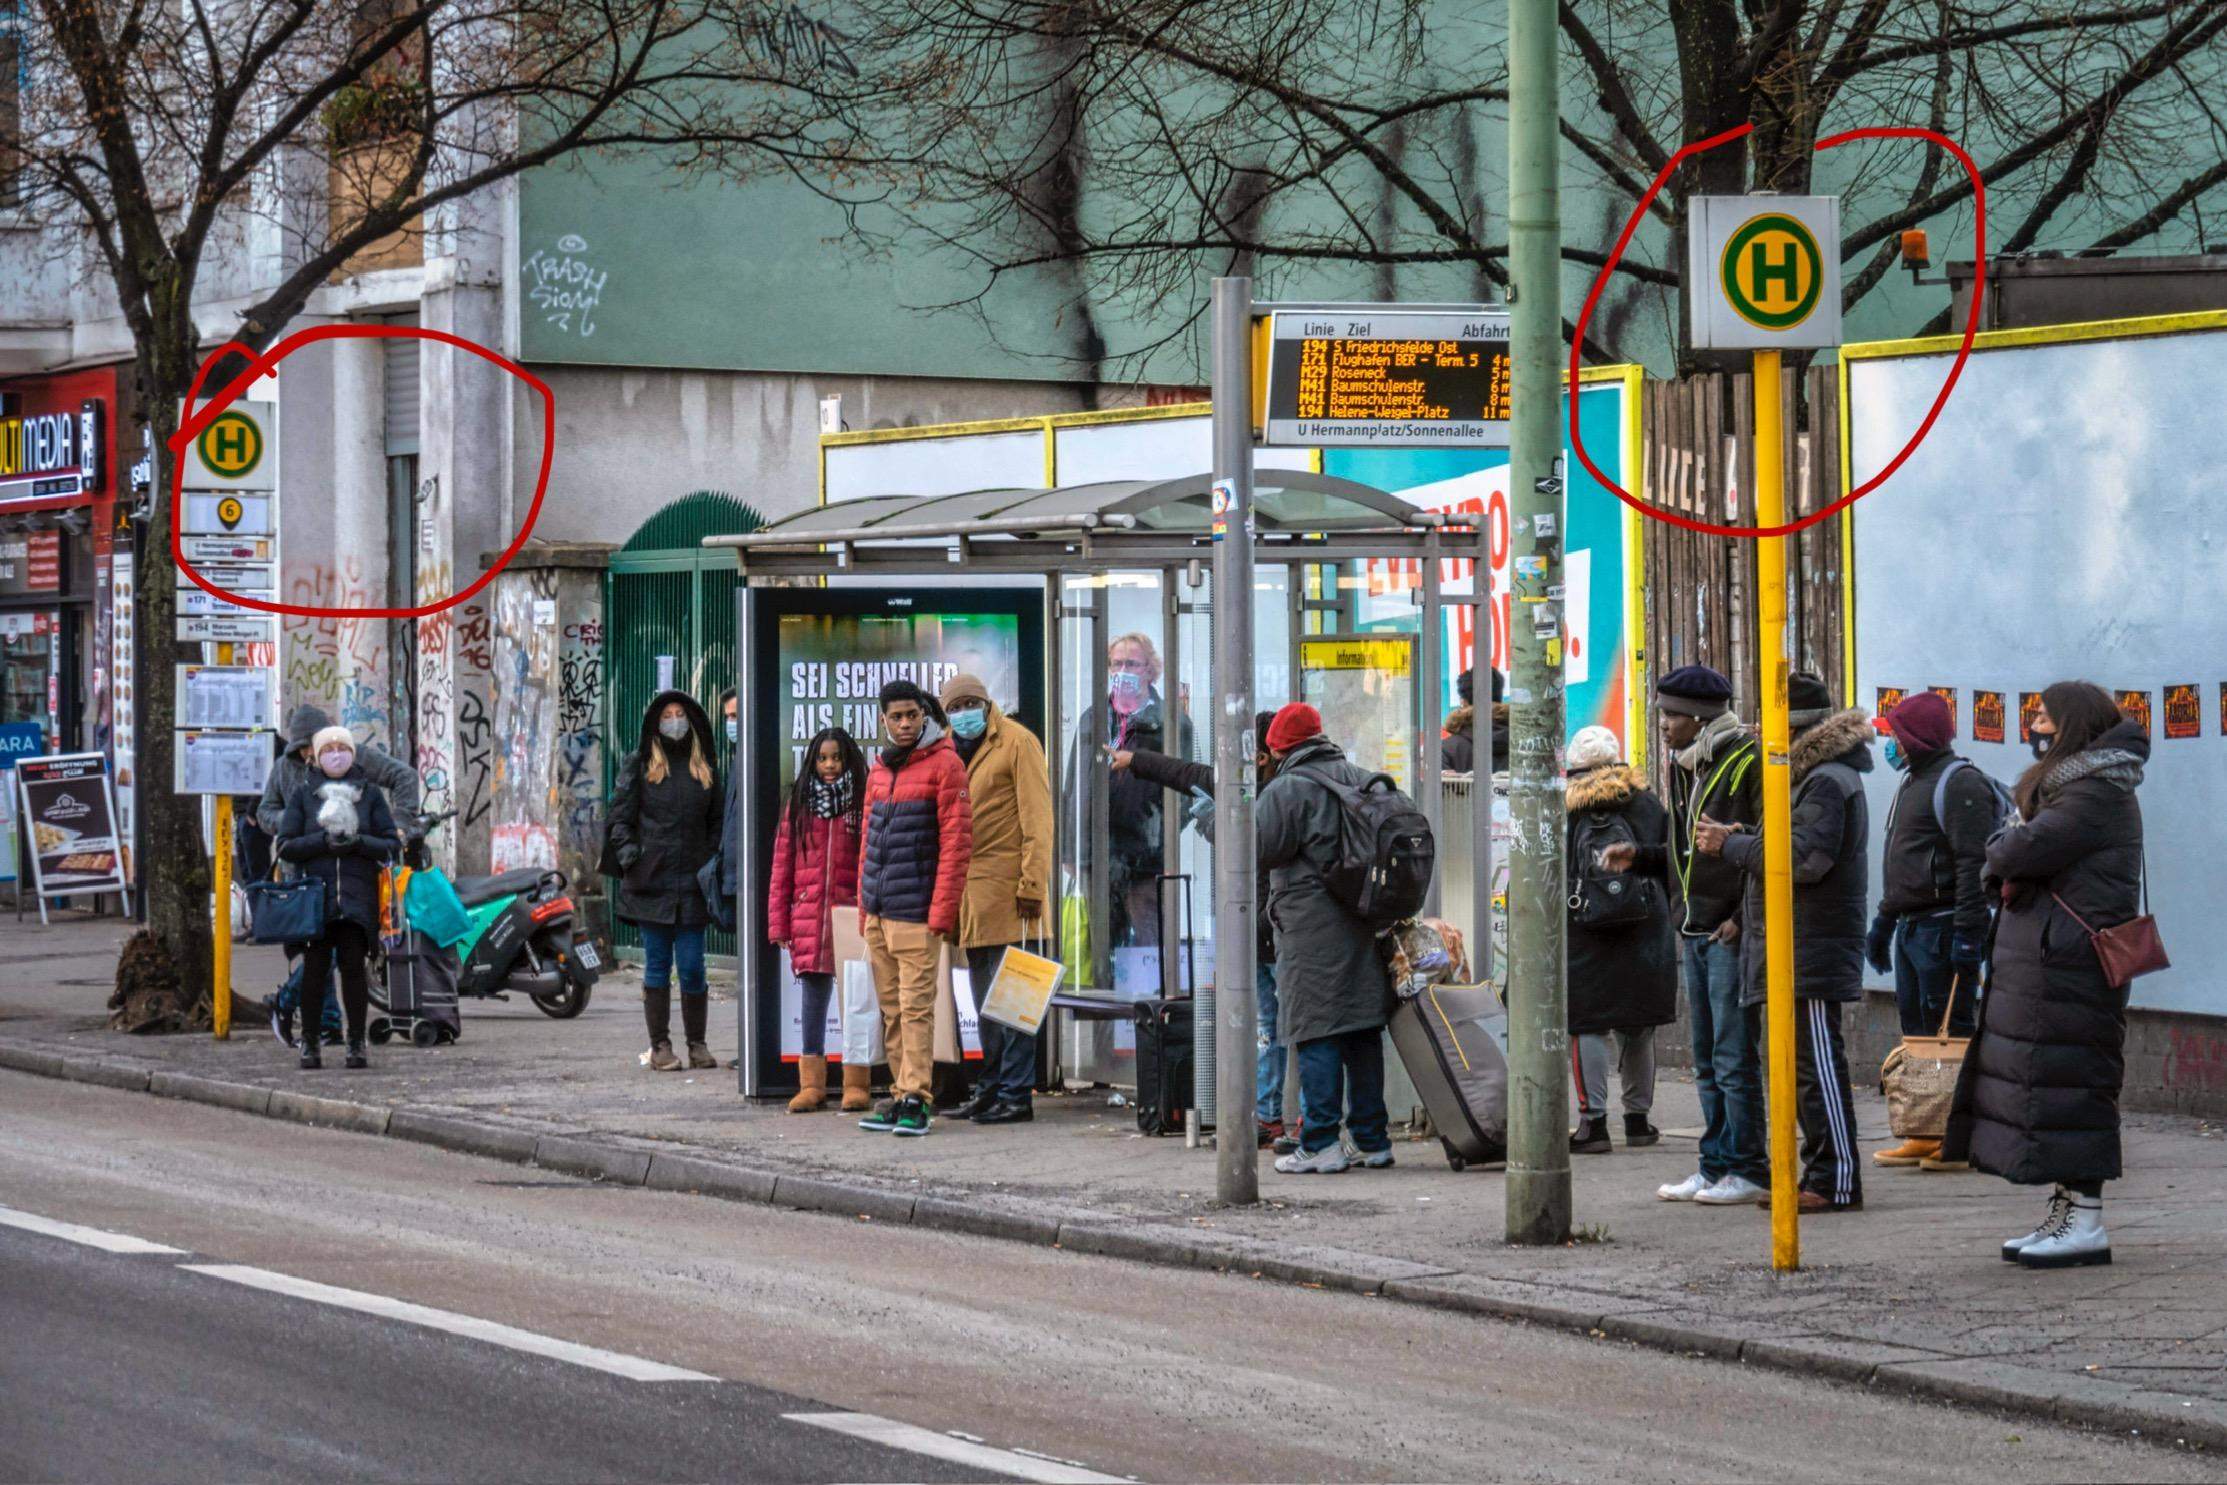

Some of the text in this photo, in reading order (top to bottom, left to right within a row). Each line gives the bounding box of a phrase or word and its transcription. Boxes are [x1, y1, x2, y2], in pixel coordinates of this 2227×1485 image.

[1752, 242, 1798, 302] H
[1304, 322, 1335, 336] Linie
[1347, 322, 1371, 337] Ziel
[1302, 340, 1459, 354] 194 S Friedrichsfelde Ost
[1302, 353, 1327, 366] 171
[1333, 353, 1391, 368] Flughafen
[1395, 353, 1416, 366] BER
[1434, 353, 1465, 367] Term.
[1469, 353, 1479, 367] 5
[1492, 354, 1501, 367] 4
[1300, 365, 1328, 379] M29
[1332, 366, 1387, 379] Roseneck
[1491, 367, 1500, 380] 5
[1300, 378, 1326, 392] M41
[1331, 379, 1426, 393] Baumschulenstr.
[1490, 380, 1499, 393] 6
[1298, 392, 1325, 405] M41
[1330, 392, 1425, 406] Baumschulenstr.
[1490, 393, 1499, 406] 8
[1298, 405, 1323, 418] 194
[1329, 405, 1450, 420] Helene-Weigel-Platz
[1483, 406, 1496, 419] 11
[1298, 423, 1484, 440] U Hermannplatz/Sonnenallee
[22, 411, 73, 473] MEDIA
[215, 426, 246, 462] H
[226, 504, 234, 517] 6
[791, 661, 828, 698] SEI
[791, 704, 878, 740] ALS EIN
